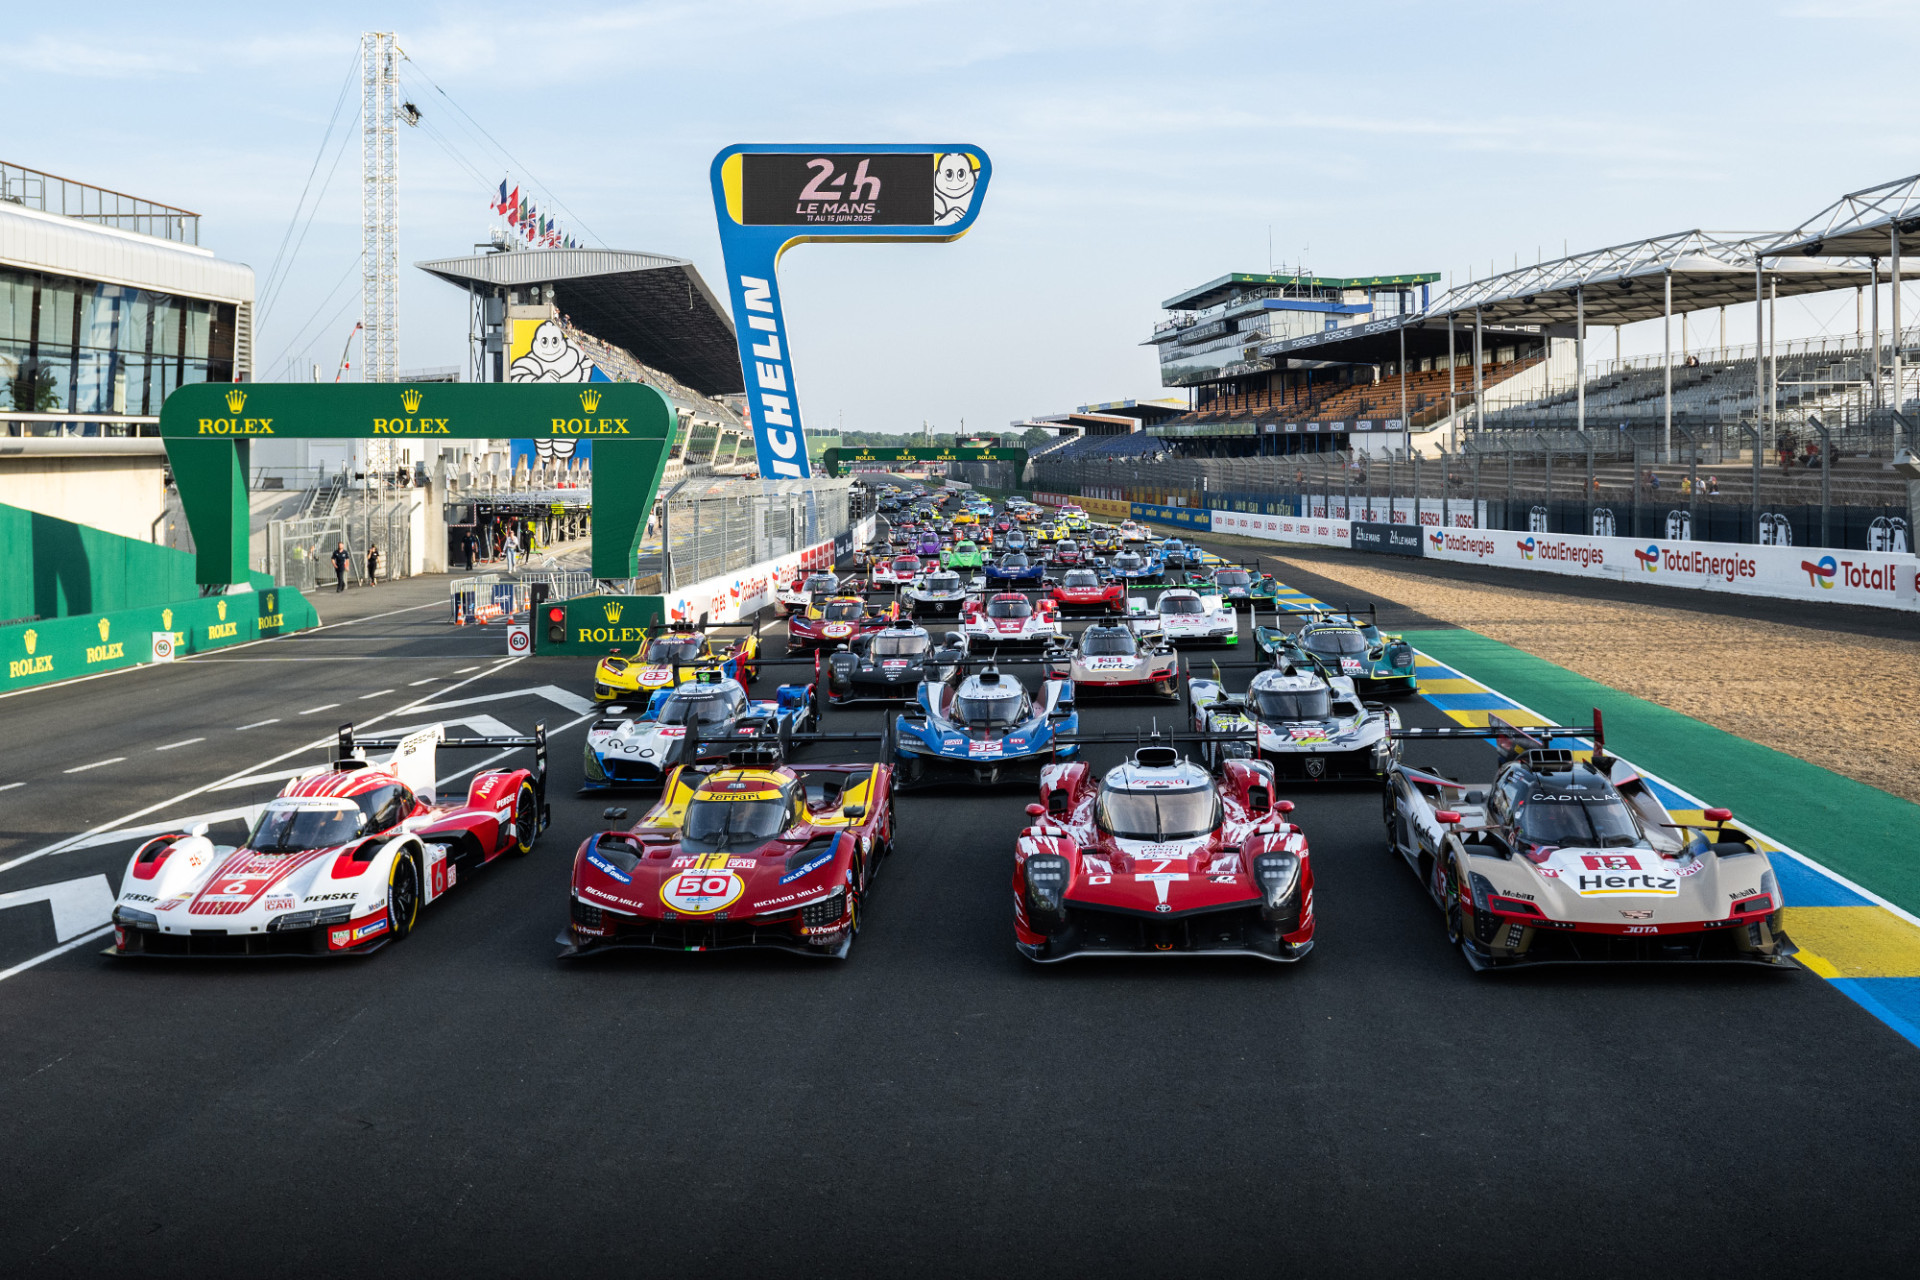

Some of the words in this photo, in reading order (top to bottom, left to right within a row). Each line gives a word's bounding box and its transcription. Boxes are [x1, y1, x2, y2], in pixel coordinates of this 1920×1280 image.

[799, 158, 881, 200] 24h
[796, 203, 818, 214] LE
[822, 203, 876, 214] MANS
[1364, 318, 1397, 332] PORSCHE
[1292, 336, 1316, 347] PORSCHE
[1324, 328, 1352, 340] PORSCHE
[1262, 343, 1283, 354] PORSCHE
[740, 275, 802, 477] ICHELIN
[198, 418, 274, 434] ROLEX
[373, 418, 450, 434] ROLEX
[551, 418, 630, 434] ROLEX
[1420, 511, 1440, 526] BOSCH
[1444, 534, 1494, 557] TotalEnergies
[1537, 540, 1604, 568] TotalEnergies
[1662, 549, 1756, 582] TotalEnergies
[258, 614, 284, 630] ROLEX
[208, 622, 237, 640] ROLEX
[578, 628, 648, 642] ROLEX
[158, 643, 168, 651] 60
[513, 636, 525, 645] 60
[86, 642, 124, 664] ROLEX
[9, 655, 54, 678] ROLEX
[476, 776, 499, 799] Ansys
[708, 792, 760, 800] Ferrari
[783, 870, 804, 883] ADLER
[812, 855, 832, 868] GROUP
[1152, 860, 1172, 872] 7
[435, 864, 444, 892] 6
[680, 878, 726, 893] 50
[1580, 875, 1677, 890] Hertz
[223, 880, 247, 894] 6
[123, 892, 160, 904] PENSKE
[304, 892, 359, 903] PENSKE
[585, 886, 618, 902] RICHARD
[618, 897, 644, 908] MILLE
[753, 894, 795, 908] RICHARD
[796, 885, 824, 898] MILLE
[810, 924, 842, 935] V-Power
